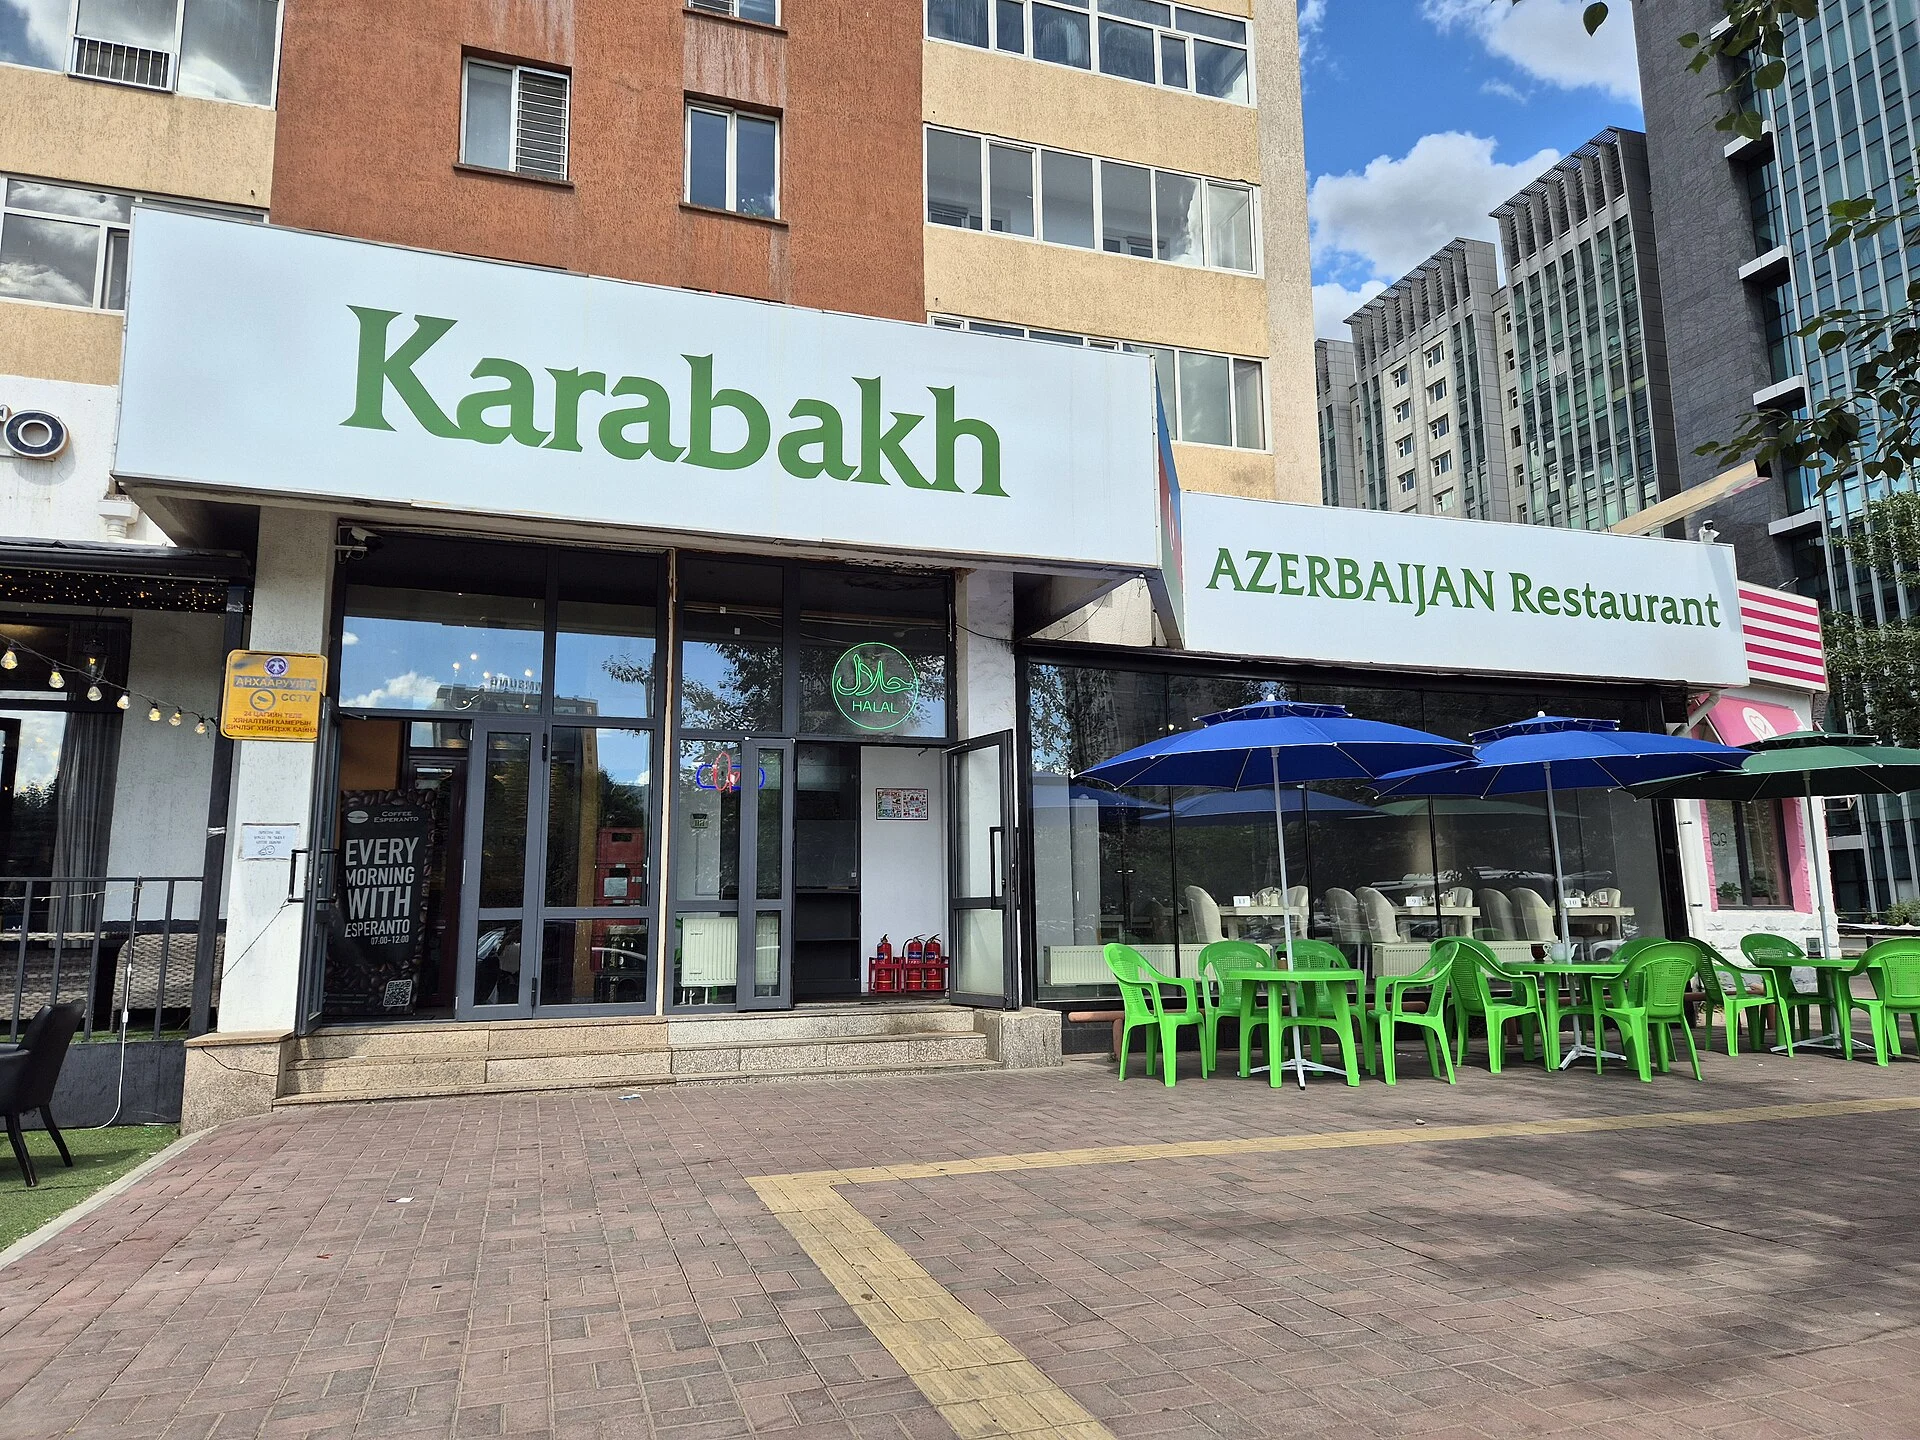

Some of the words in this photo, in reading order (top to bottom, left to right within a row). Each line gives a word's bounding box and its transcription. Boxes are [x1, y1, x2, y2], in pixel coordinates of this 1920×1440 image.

[338, 304, 1011, 498] Karabakh
[1205, 547, 1495, 617] AZERBAIJAN
[1508, 572, 1721, 628] Restaurant
[837, 654, 914, 696] حلال
[281, 693, 311, 702] CCTV
[852, 701, 899, 714] HALAL
[345, 837, 419, 866] EVERY
[346, 866, 415, 887] MORNING
[347, 886, 411, 920] WITH
[344, 919, 411, 938] ESPERANTO
